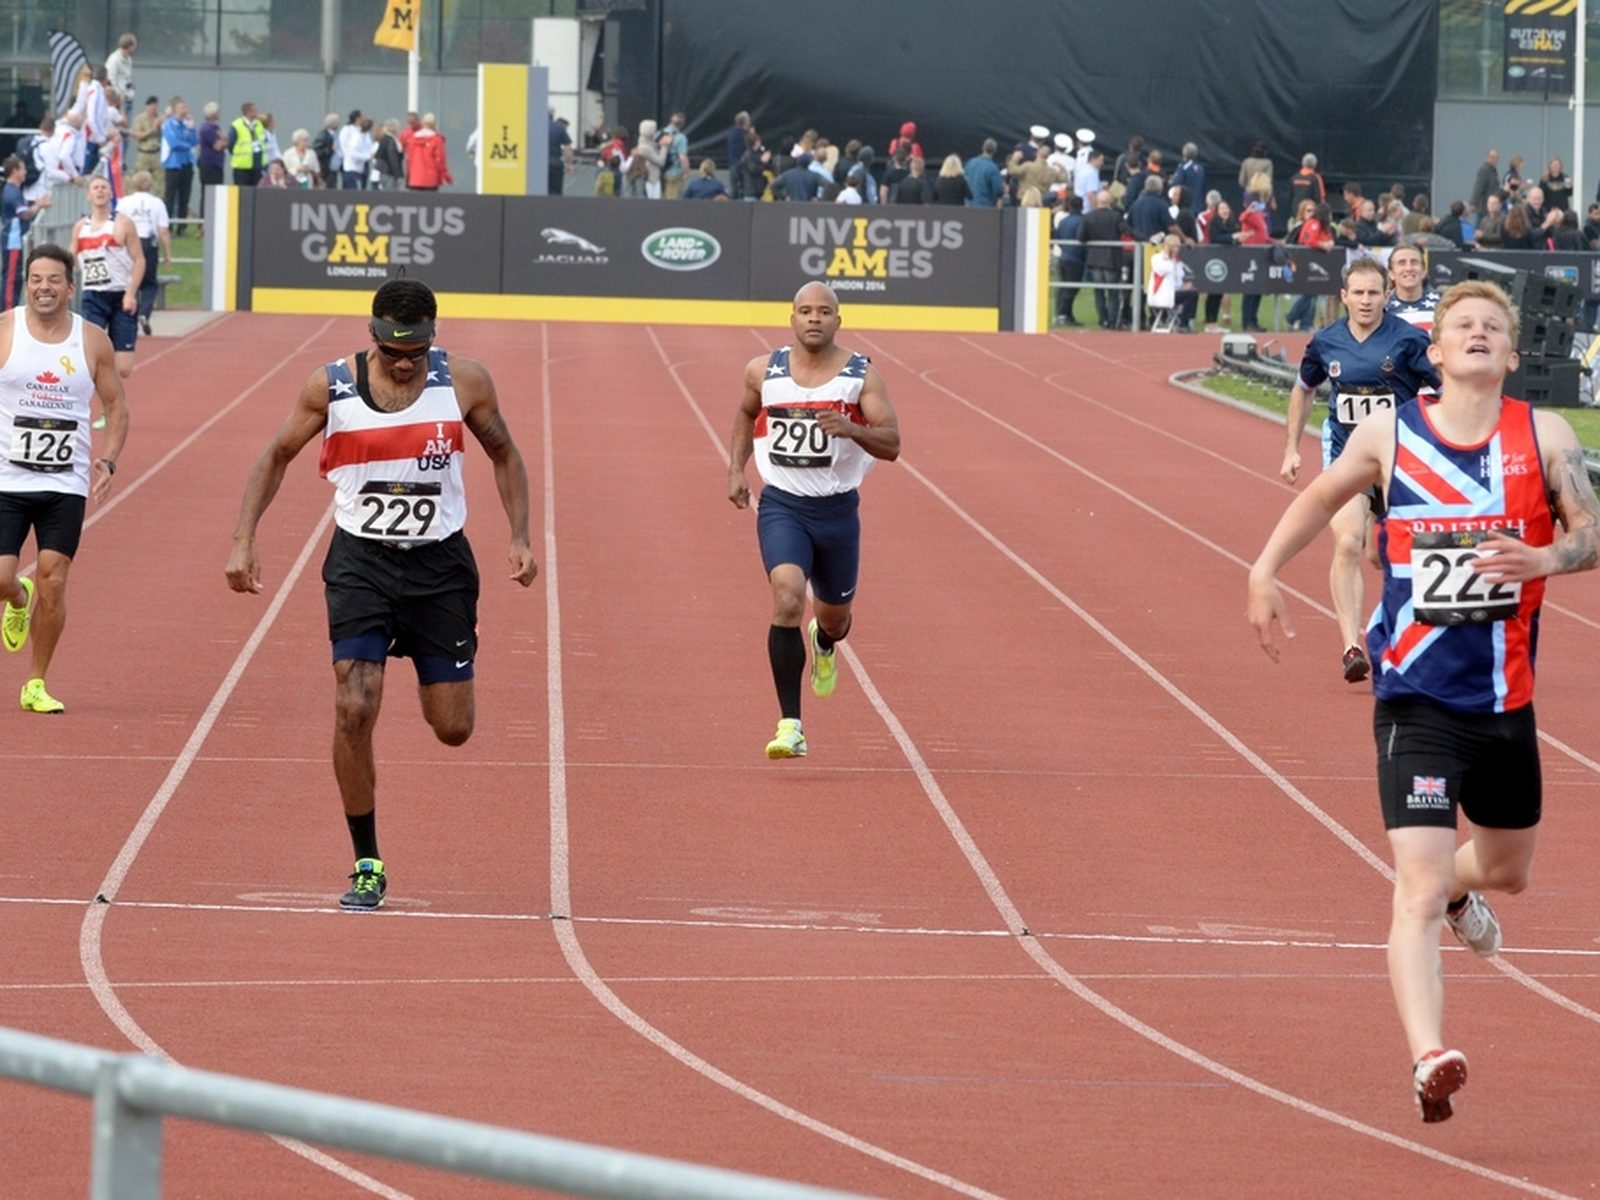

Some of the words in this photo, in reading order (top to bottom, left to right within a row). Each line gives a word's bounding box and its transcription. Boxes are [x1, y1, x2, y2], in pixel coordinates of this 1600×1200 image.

[502, 125, 509, 142] I
[490, 143, 518, 160] AM
[290, 203, 466, 236] INVICTUS
[789, 216, 965, 249] INVICTUS
[301, 233, 436, 265] GAMES
[659, 236, 695, 249] LAND
[534, 253, 610, 265] JAGUAR
[663, 248, 707, 261] ROVER
[84, 262, 108, 280] 233
[800, 247, 934, 279] GAMES
[327, 266, 366, 277] LONDON
[367, 267, 388, 278] 2014
[865, 281, 886, 291] 2014
[26, 382, 70, 393] CANADIAN
[436, 423, 444, 438] I
[772, 420, 829, 454] 290
[20, 430, 73, 462] 126
[423, 439, 453, 455] AM
[1480, 454, 1511, 466] HP
[1480, 464, 1529, 477] HOES
[361, 495, 436, 536] 229
